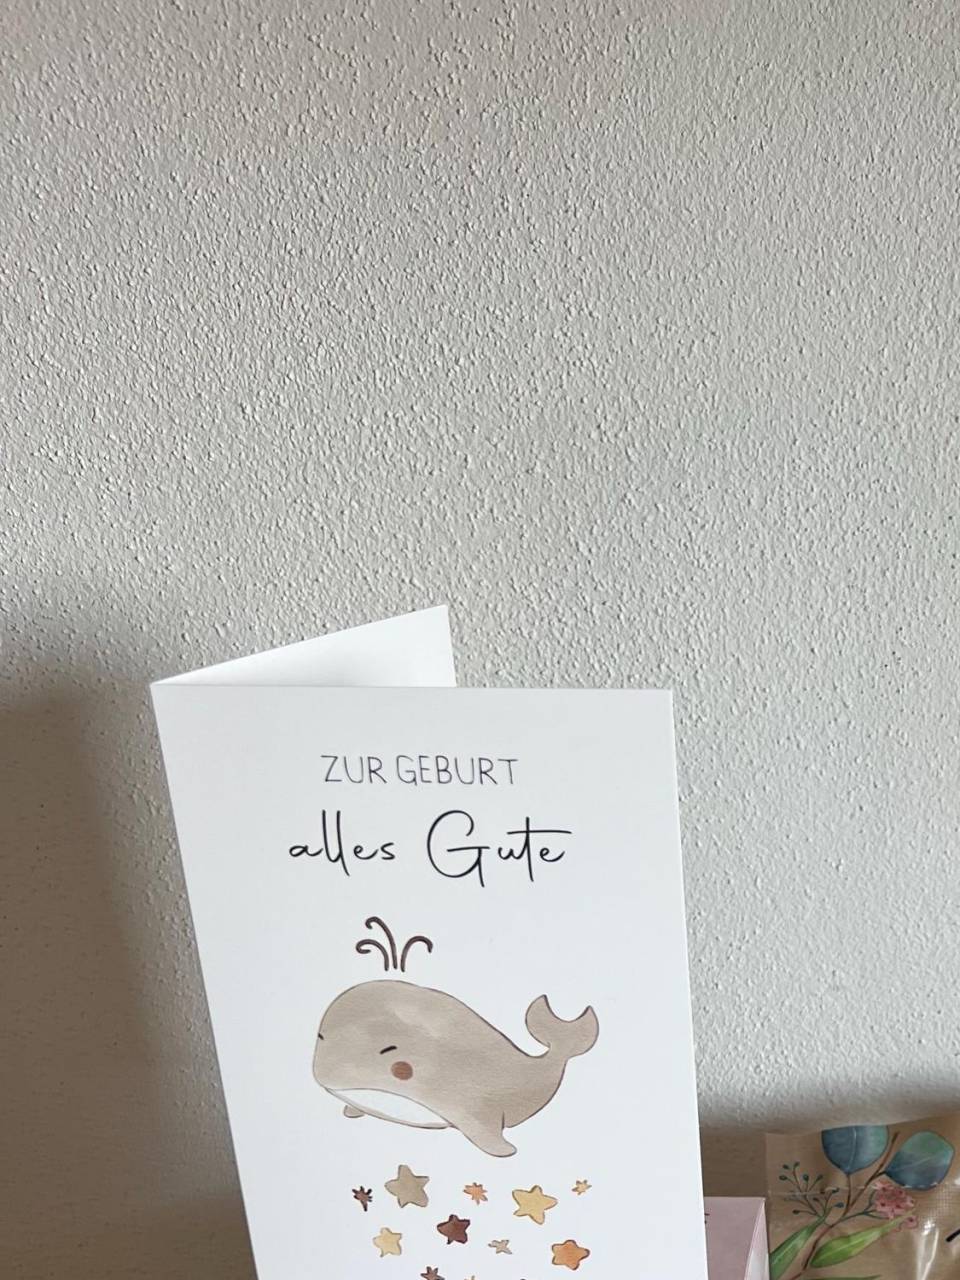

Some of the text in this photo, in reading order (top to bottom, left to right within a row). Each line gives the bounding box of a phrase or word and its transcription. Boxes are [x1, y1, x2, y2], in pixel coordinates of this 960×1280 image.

[321, 755, 518, 786] ZUR GEBURT
[289, 809, 573, 888] alles Gute
